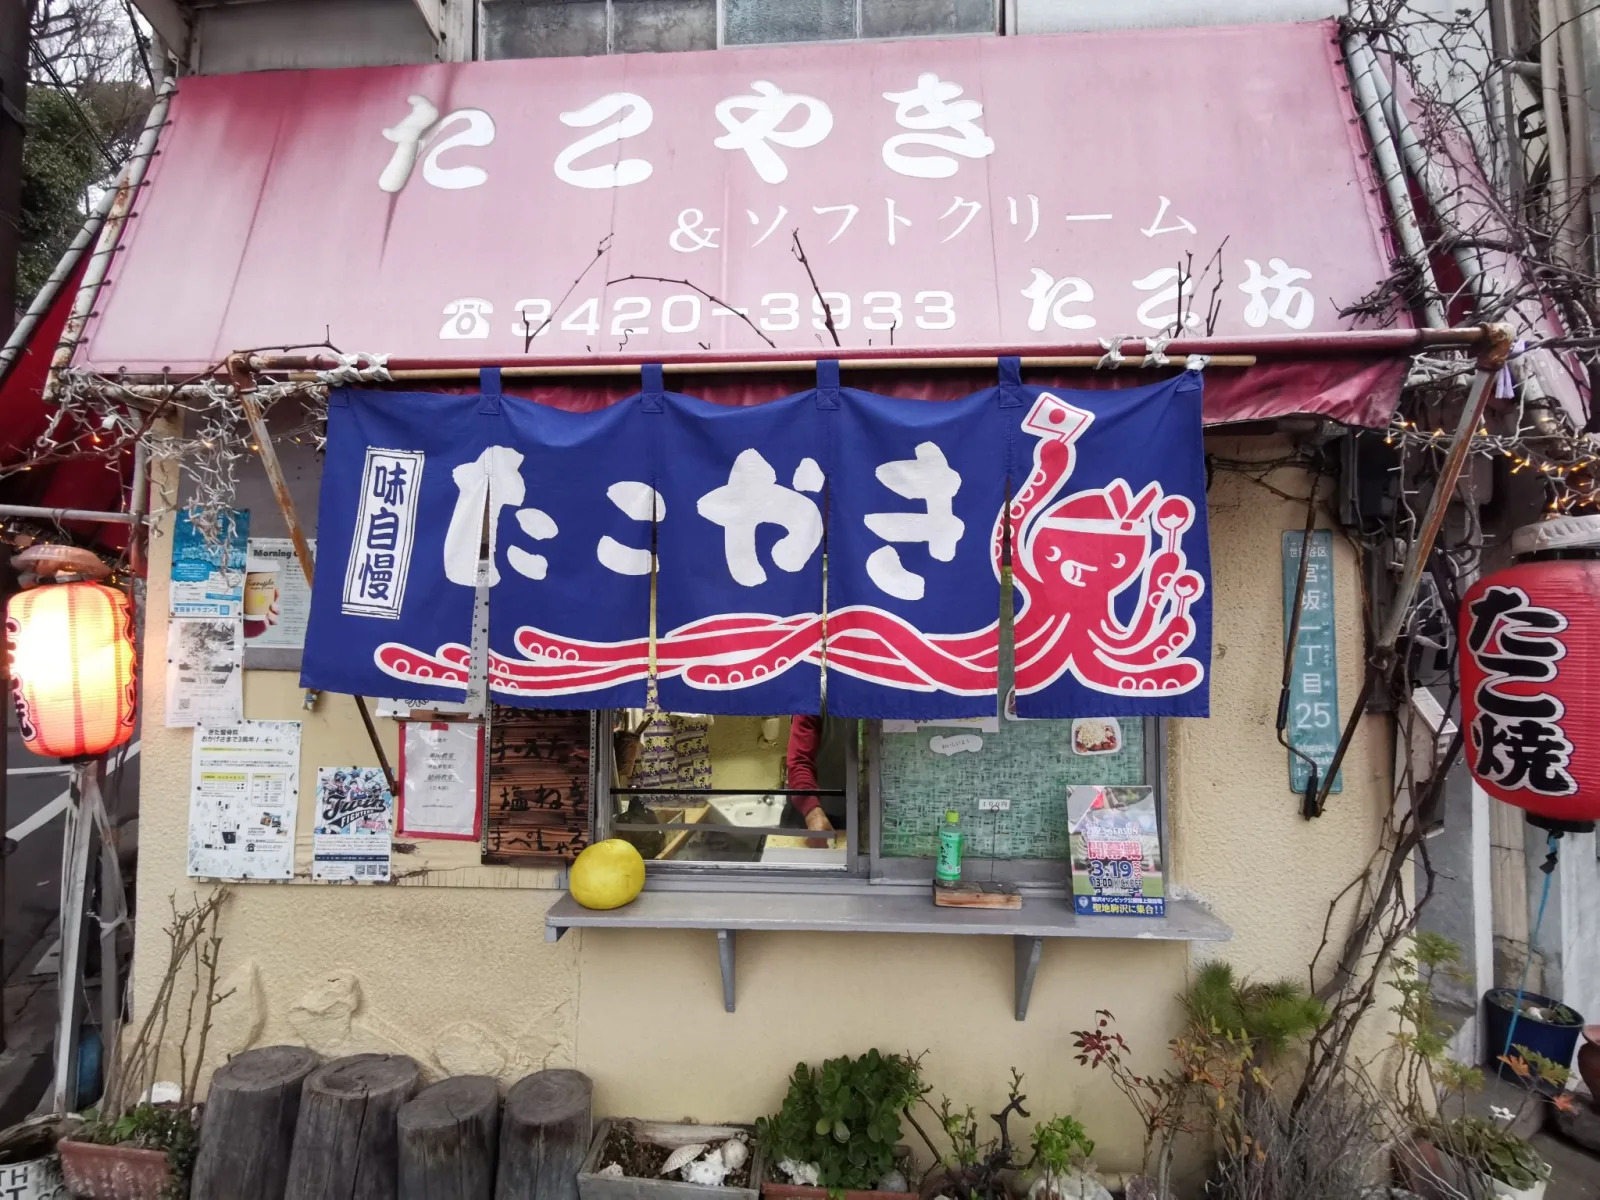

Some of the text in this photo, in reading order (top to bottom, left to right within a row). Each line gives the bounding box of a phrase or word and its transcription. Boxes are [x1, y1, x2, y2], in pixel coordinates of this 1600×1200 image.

[378, 71, 995, 193] たこやき
[669, 194, 1198, 253] & ソフトクリーム
[511, 289, 957, 338] 3420-3933
[1020, 258, 1313, 333] たこ坊
[358, 461, 407, 601] 味自慢
[443, 441, 965, 601] たこやき
[253, 549, 292, 559] Morning
[1295, 702, 1332, 729] 25
[1467, 587, 1577, 795] たこ焼
[1088, 841, 1142, 860] 開幕戦
[1091, 860, 1133, 878] 3.19
[1093, 878, 1113, 888] 13:00
